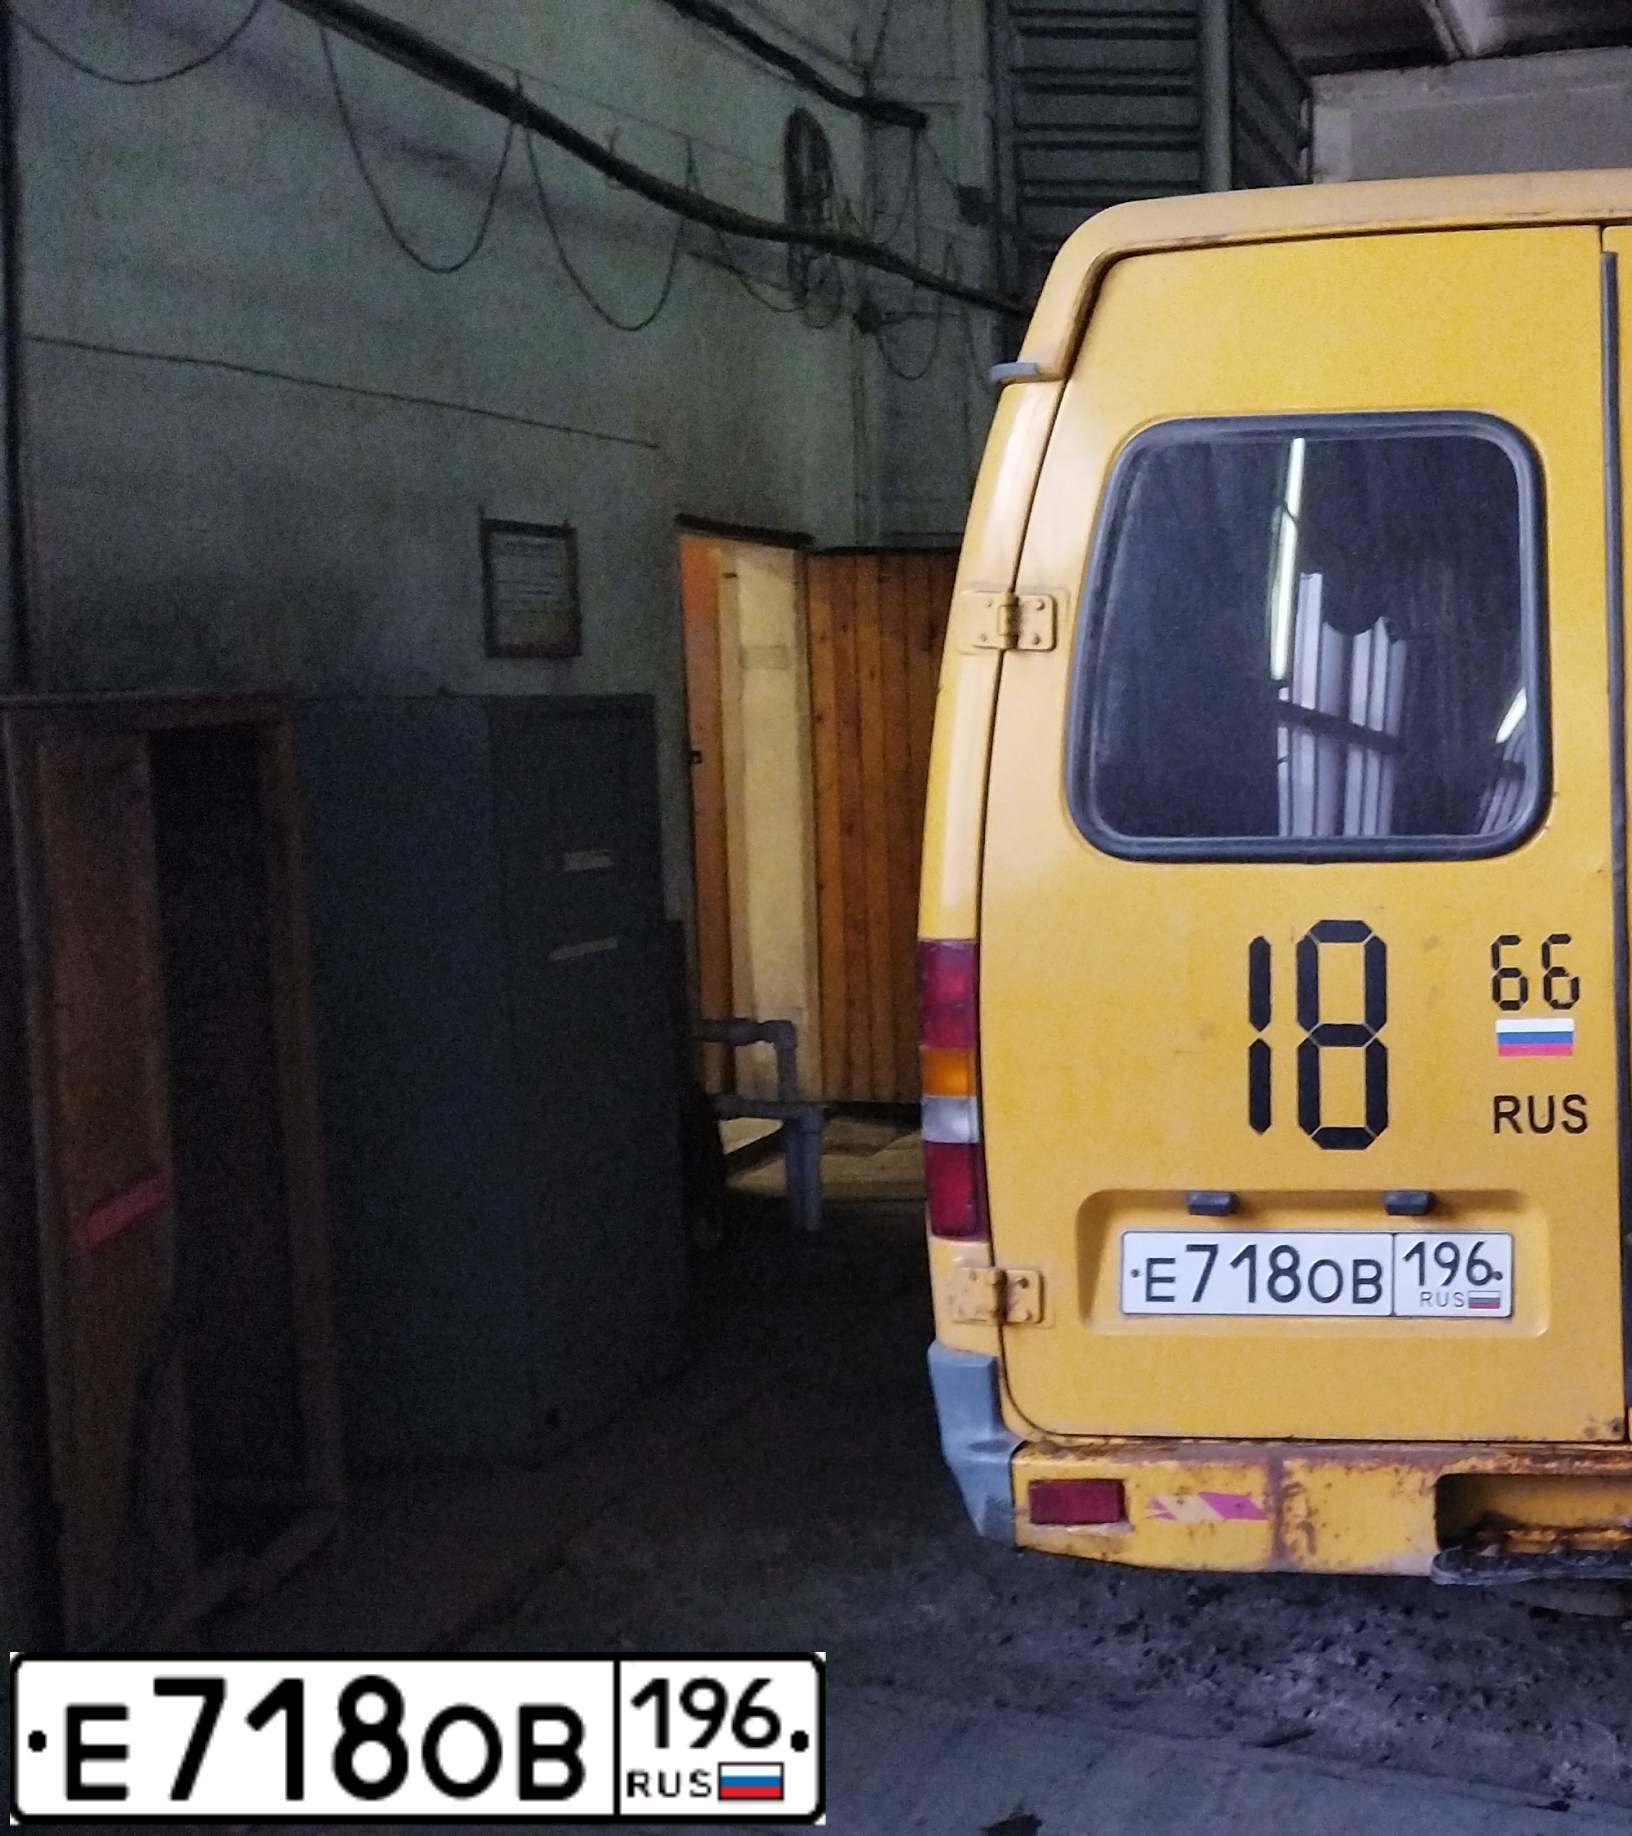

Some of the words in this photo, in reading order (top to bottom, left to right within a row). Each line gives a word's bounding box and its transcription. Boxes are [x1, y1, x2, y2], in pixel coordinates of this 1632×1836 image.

[1491, 933, 1581, 1012] 66
[1248, 919, 1389, 1151] 18
[1492, 1093, 1589, 1136] RUS
[1402, 1241, 1493, 1288] 196
[1419, 1290, 1467, 1308] RUS
